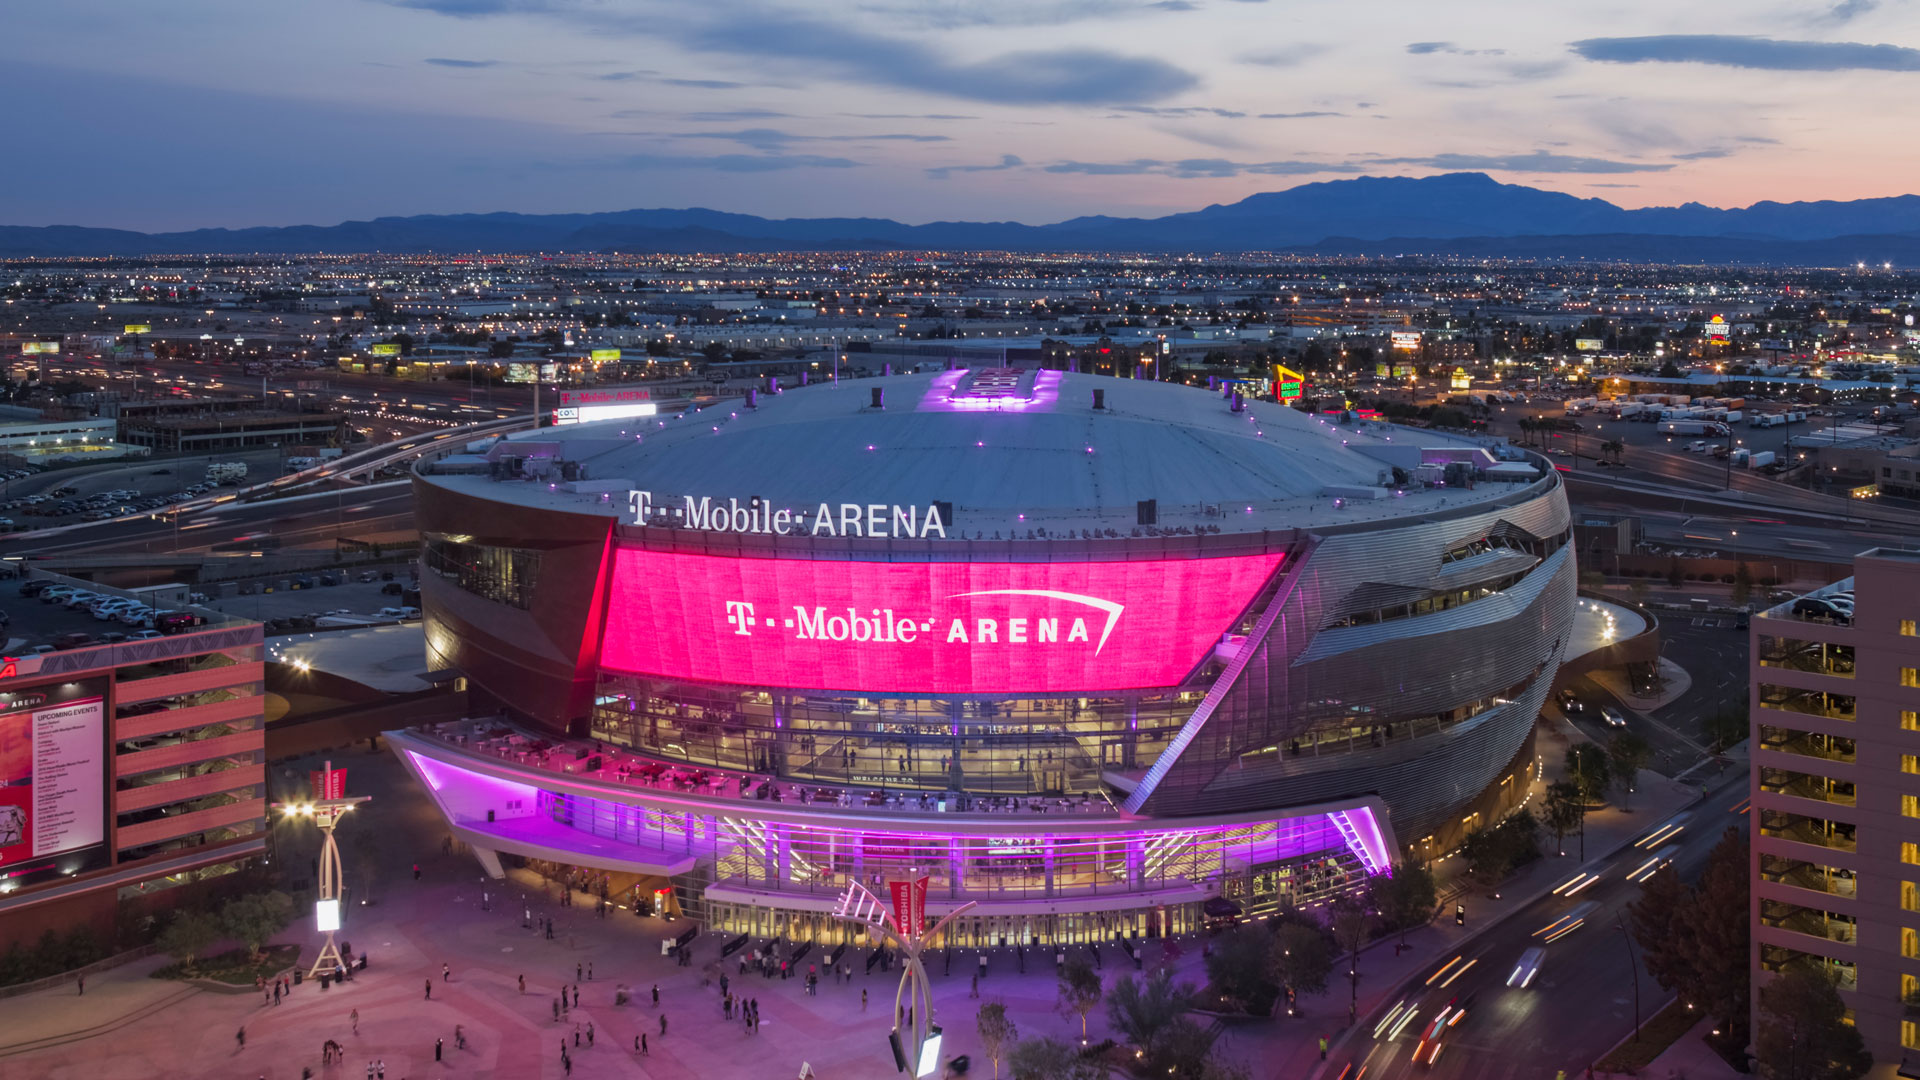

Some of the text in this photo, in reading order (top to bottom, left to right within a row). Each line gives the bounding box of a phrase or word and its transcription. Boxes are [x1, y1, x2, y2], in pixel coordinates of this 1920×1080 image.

[616, 391, 649, 401] ARENA
[812, 503, 947, 538] ARENA
[946, 617, 1089, 643] ARENA
[11, 697, 41, 708] ARENA
[37, 705, 98, 721] UPCOMING EVENTS
[332, 771, 340, 800] SHIBA
[900, 884, 909, 928] TOSHIBA
